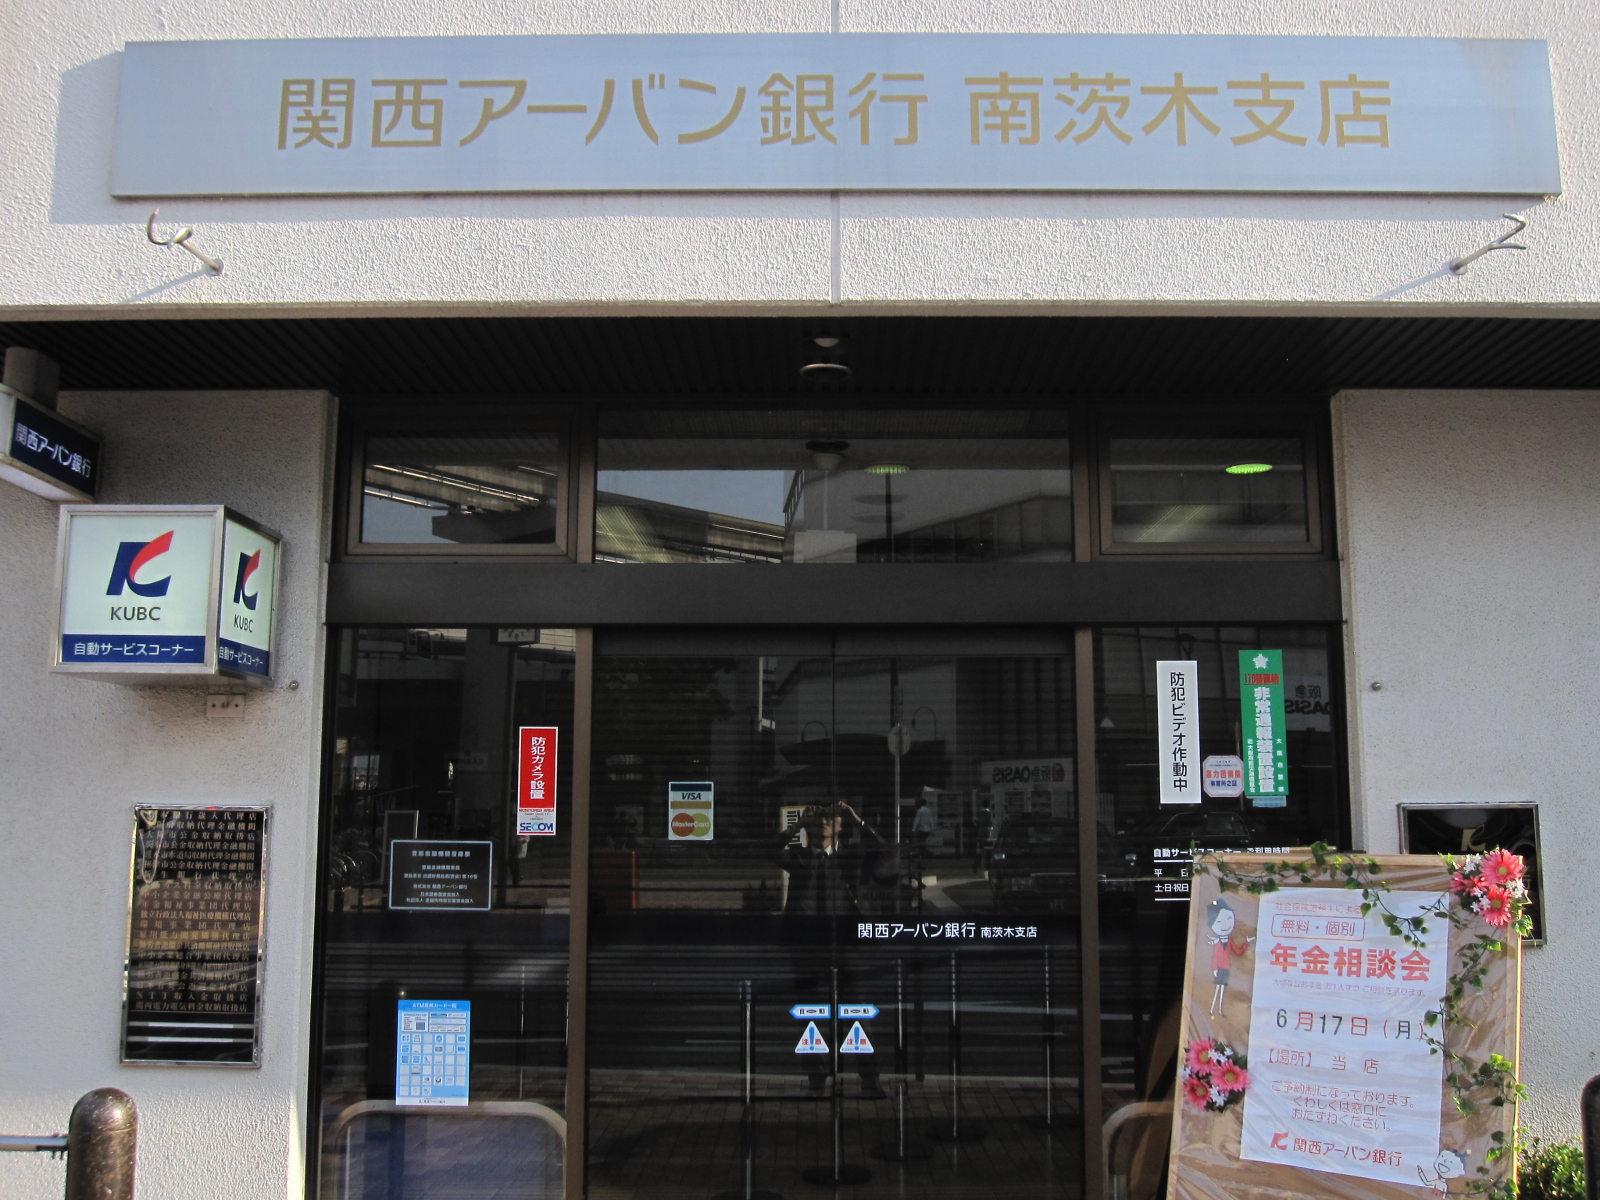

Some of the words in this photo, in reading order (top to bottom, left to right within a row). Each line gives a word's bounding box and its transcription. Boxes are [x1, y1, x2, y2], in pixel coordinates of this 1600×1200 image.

[277, 72, 929, 151] 関西アーバン銀行
[964, 71, 1391, 149] 南茨木支店
[15, 422, 92, 479] 関西アーバン銀行
[110, 606, 161, 621] KUBC
[233, 613, 254, 634] KUBC
[74, 641, 195, 657] 自動サービスコーナー
[217, 644, 264, 667] 自動サービスコーナー
[1170, 671, 1188, 792] 防犯ビデオ作動中
[530, 737, 547, 800] 防犯カメラ設置
[1205, 769, 1241, 779] 暴力団排除
[681, 792, 701, 800] VISA
[519, 822, 553, 832] SECOM
[857, 922, 976, 938] 関西アーバン銀行
[980, 925, 1038, 938] 南茨木支店
[1280, 918, 1356, 937] 無料・個別
[1269, 942, 1431, 982] 年金相談会
[1271, 1080, 1414, 1108] ご予約制になっております。
[1293, 1095, 1387, 1117] くわしくは窓口に
[1291, 1107, 1391, 1132] おたずねください。
[1293, 1137, 1403, 1167] 関西アーバン銀行
